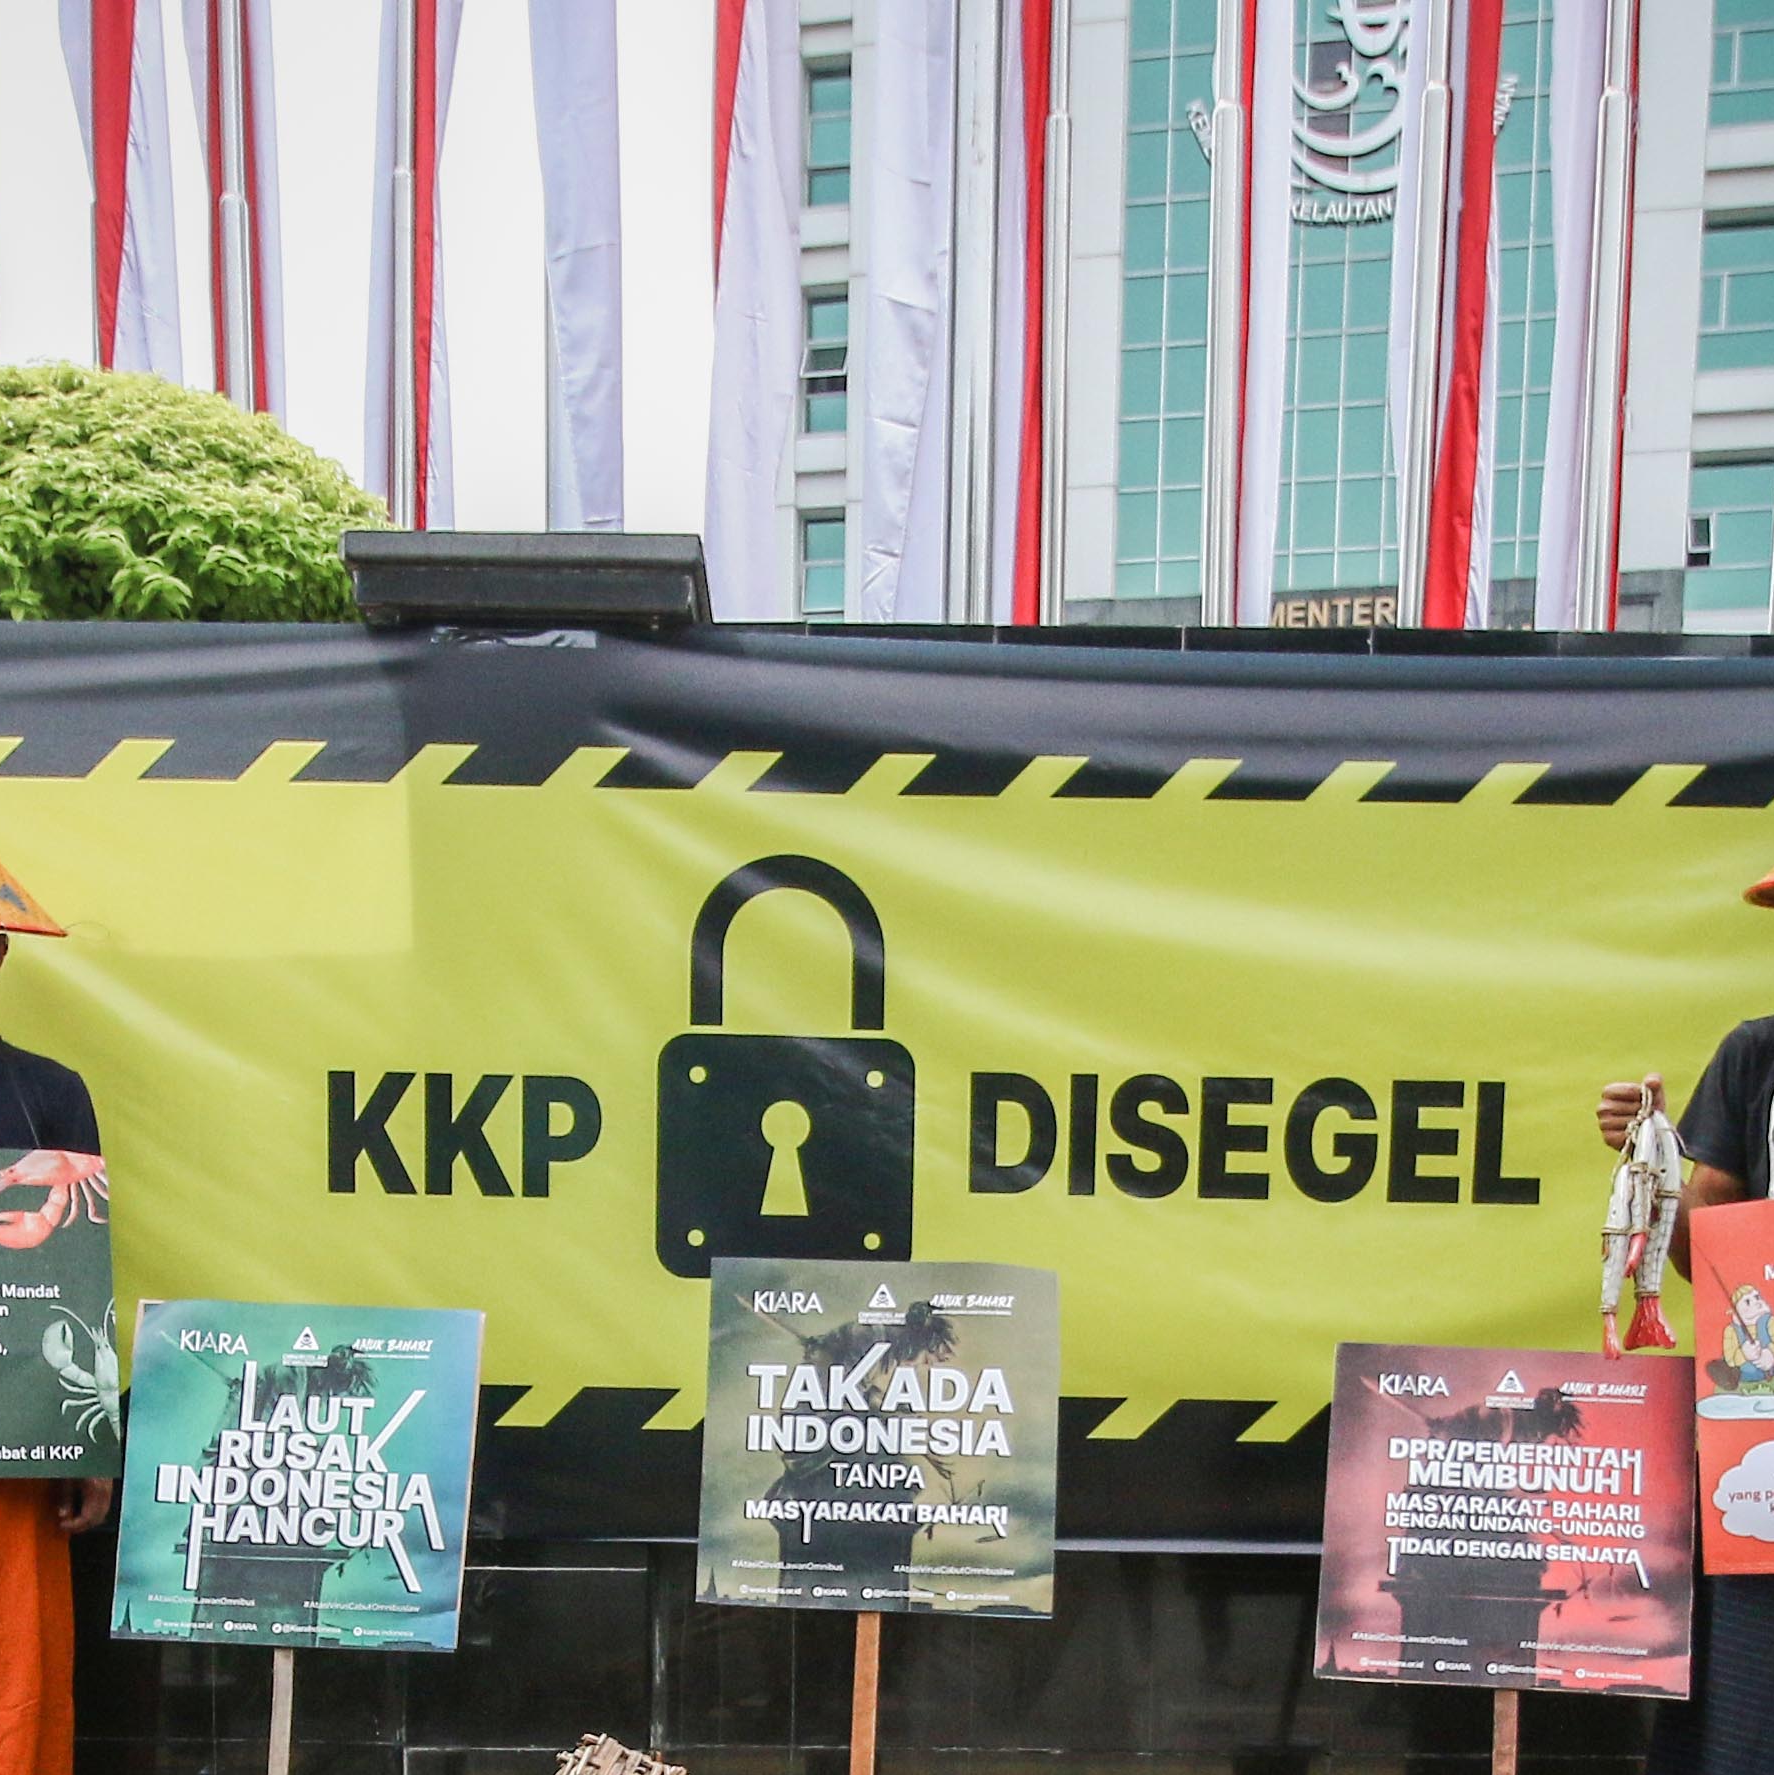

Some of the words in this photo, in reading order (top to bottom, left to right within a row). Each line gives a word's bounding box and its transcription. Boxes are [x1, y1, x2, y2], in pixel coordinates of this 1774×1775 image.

[1272, 597, 1397, 628] MENTER
[327, 1069, 602, 1198] KKP
[968, 1072, 1541, 1205] DISEGEL
[754, 1291, 823, 1314] KIARA
[179, 1329, 248, 1355] KIARA
[240, 1361, 375, 1435] LAUT
[748, 1342, 891, 1411] TAK
[881, 1368, 1013, 1414] ADA
[1378, 1374, 1449, 1396] KIARA
[219, 1390, 426, 1472] RUSAK
[747, 1415, 1011, 1457] INDONESIA
[830, 1462, 925, 1490] TANPA
[1389, 1438, 1641, 1495] DPR/PEMERINTAH
[1408, 1460, 1620, 1494] MEMBUNUH
[156, 1465, 445, 1551] INDONESIA
[745, 1500, 913, 1544] MASYARAKAT
[917, 1504, 1008, 1537] BAHARI
[1385, 1511, 1465, 1531] DENGAN
[1470, 1516, 1645, 1539] UNDANG-UNDANG
[1387, 1493, 1548, 1519] MASYARAKAT
[1552, 1501, 1640, 1522] BAHARI
[184, 1504, 422, 1593] HANCUR
[1387, 1537, 1450, 1575] TIDAK
[1453, 1540, 1542, 1560] DENGAN
[1546, 1545, 1649, 1589] SENJATA
